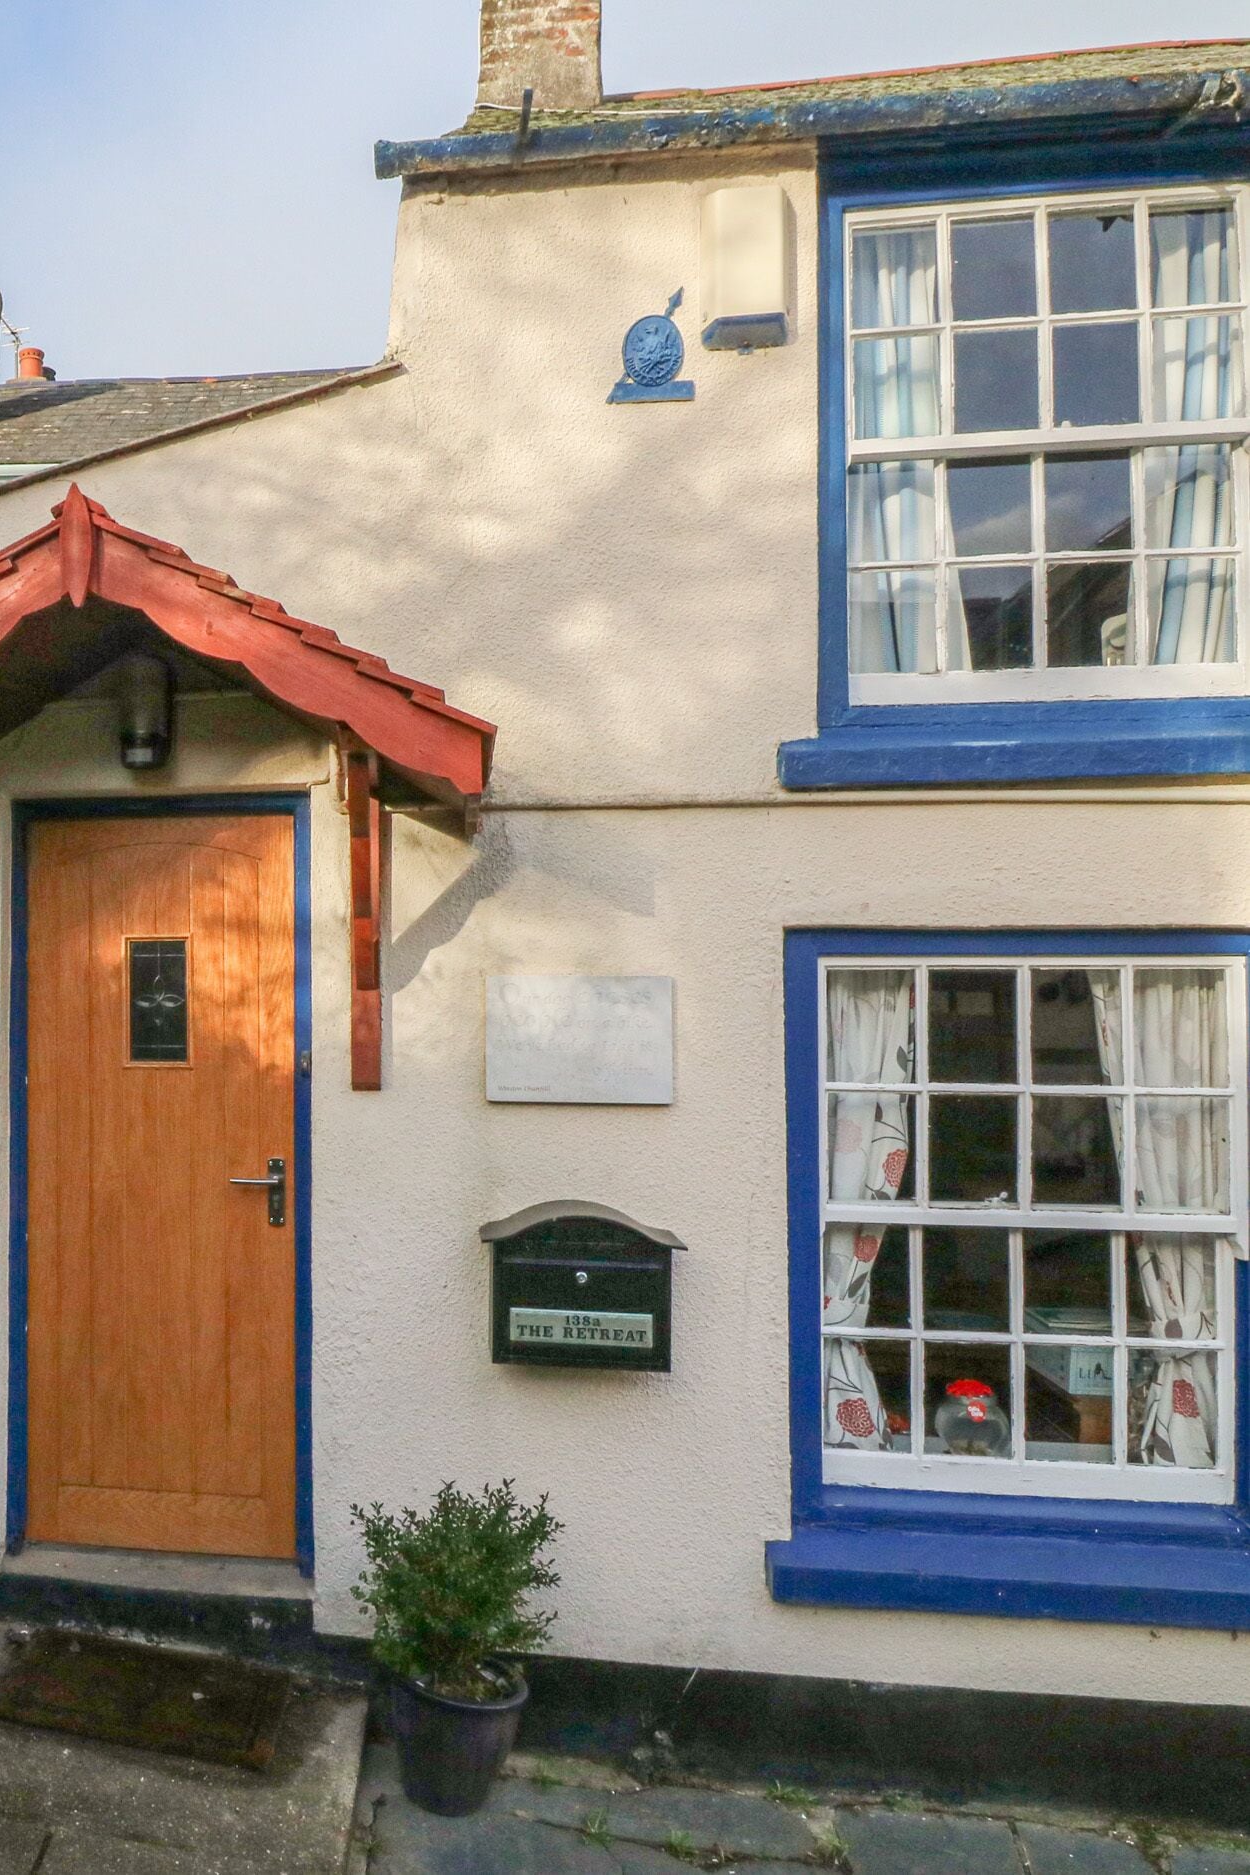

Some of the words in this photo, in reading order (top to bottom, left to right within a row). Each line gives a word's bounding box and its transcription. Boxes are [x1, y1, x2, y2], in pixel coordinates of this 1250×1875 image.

[565, 1315, 601, 1327] 138a
[516, 1324, 554, 1338] THE
[563, 1327, 647, 1343] RETREAT
